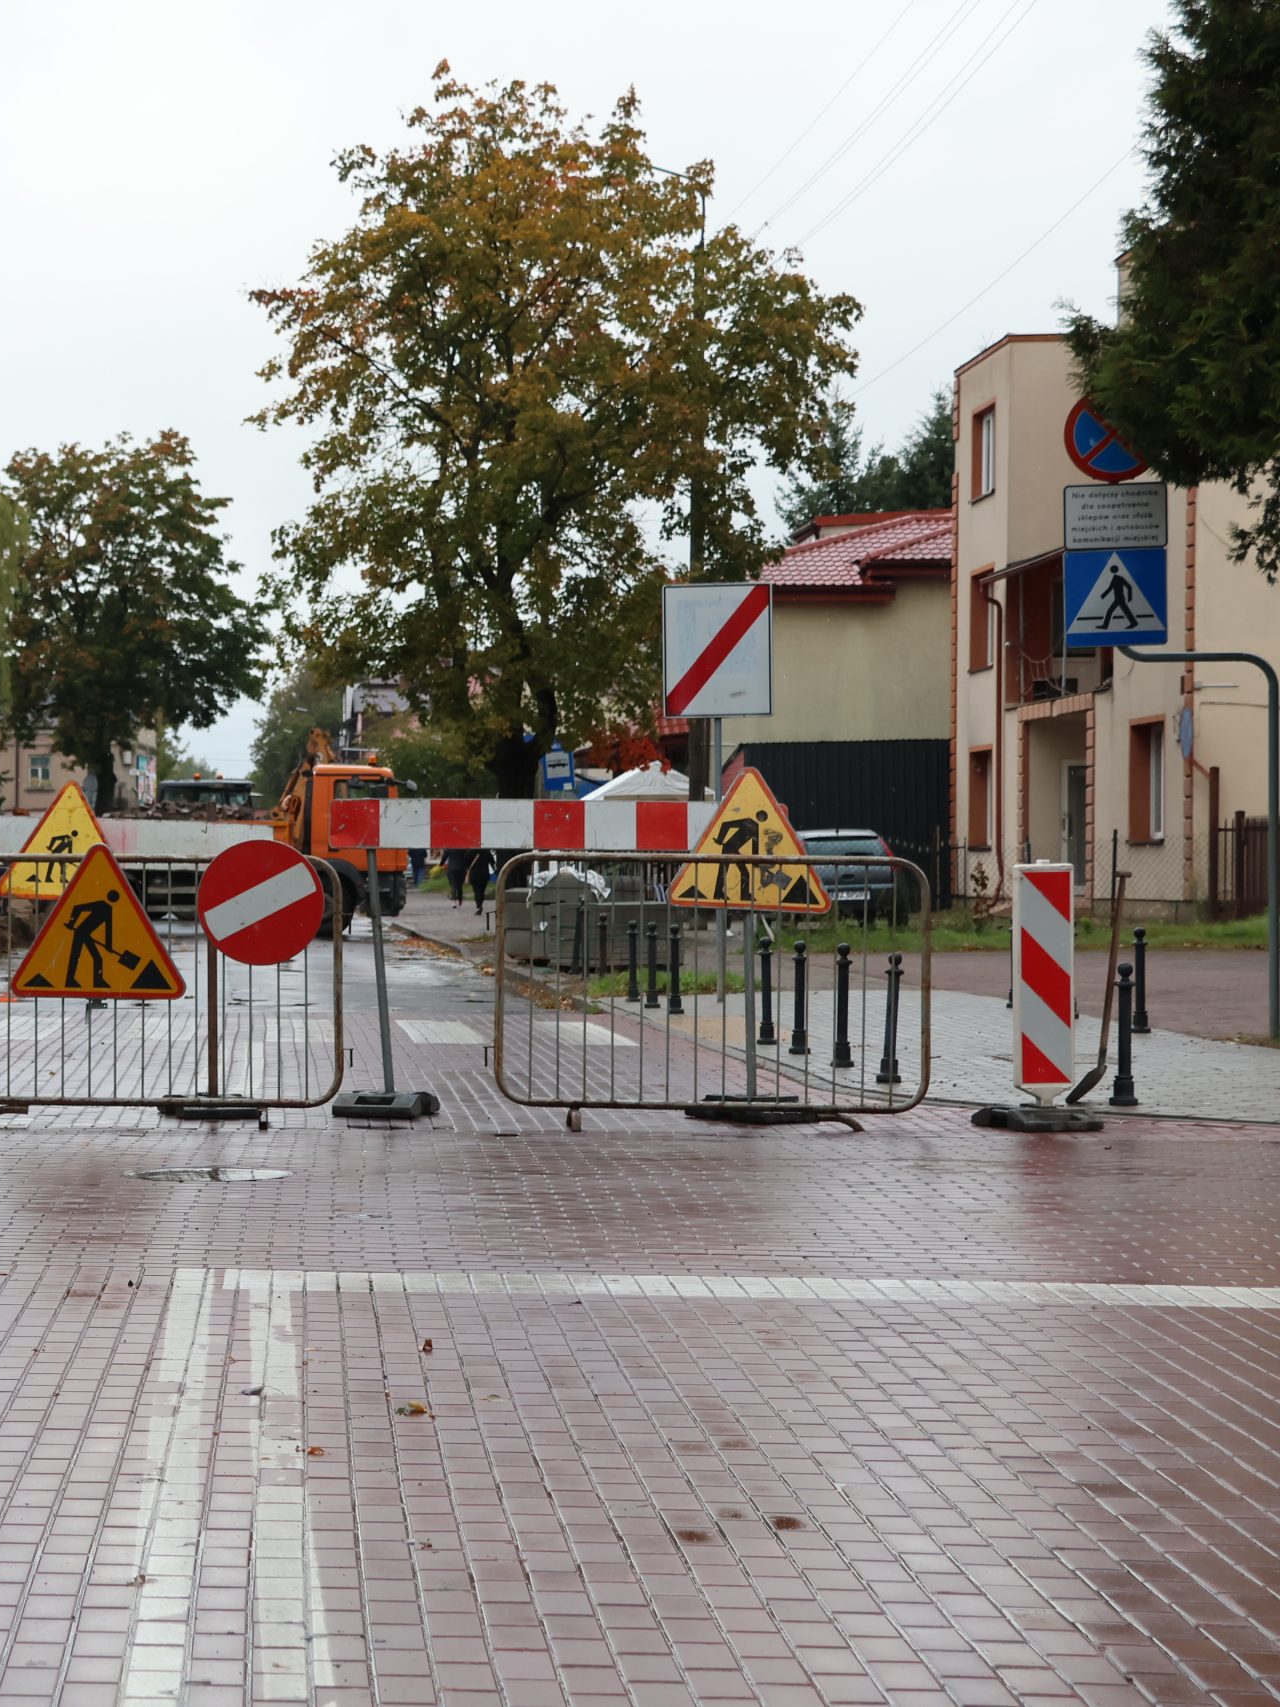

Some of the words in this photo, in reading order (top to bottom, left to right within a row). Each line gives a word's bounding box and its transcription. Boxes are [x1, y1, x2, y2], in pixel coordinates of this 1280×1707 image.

[1072, 491, 1085, 499] Nie
[1088, 491, 1118, 500] dotyczy
[1071, 525, 1108, 533] miejskich
[1073, 535, 1120, 544] komunikacji
[1123, 534, 1159, 543] miejskiej
